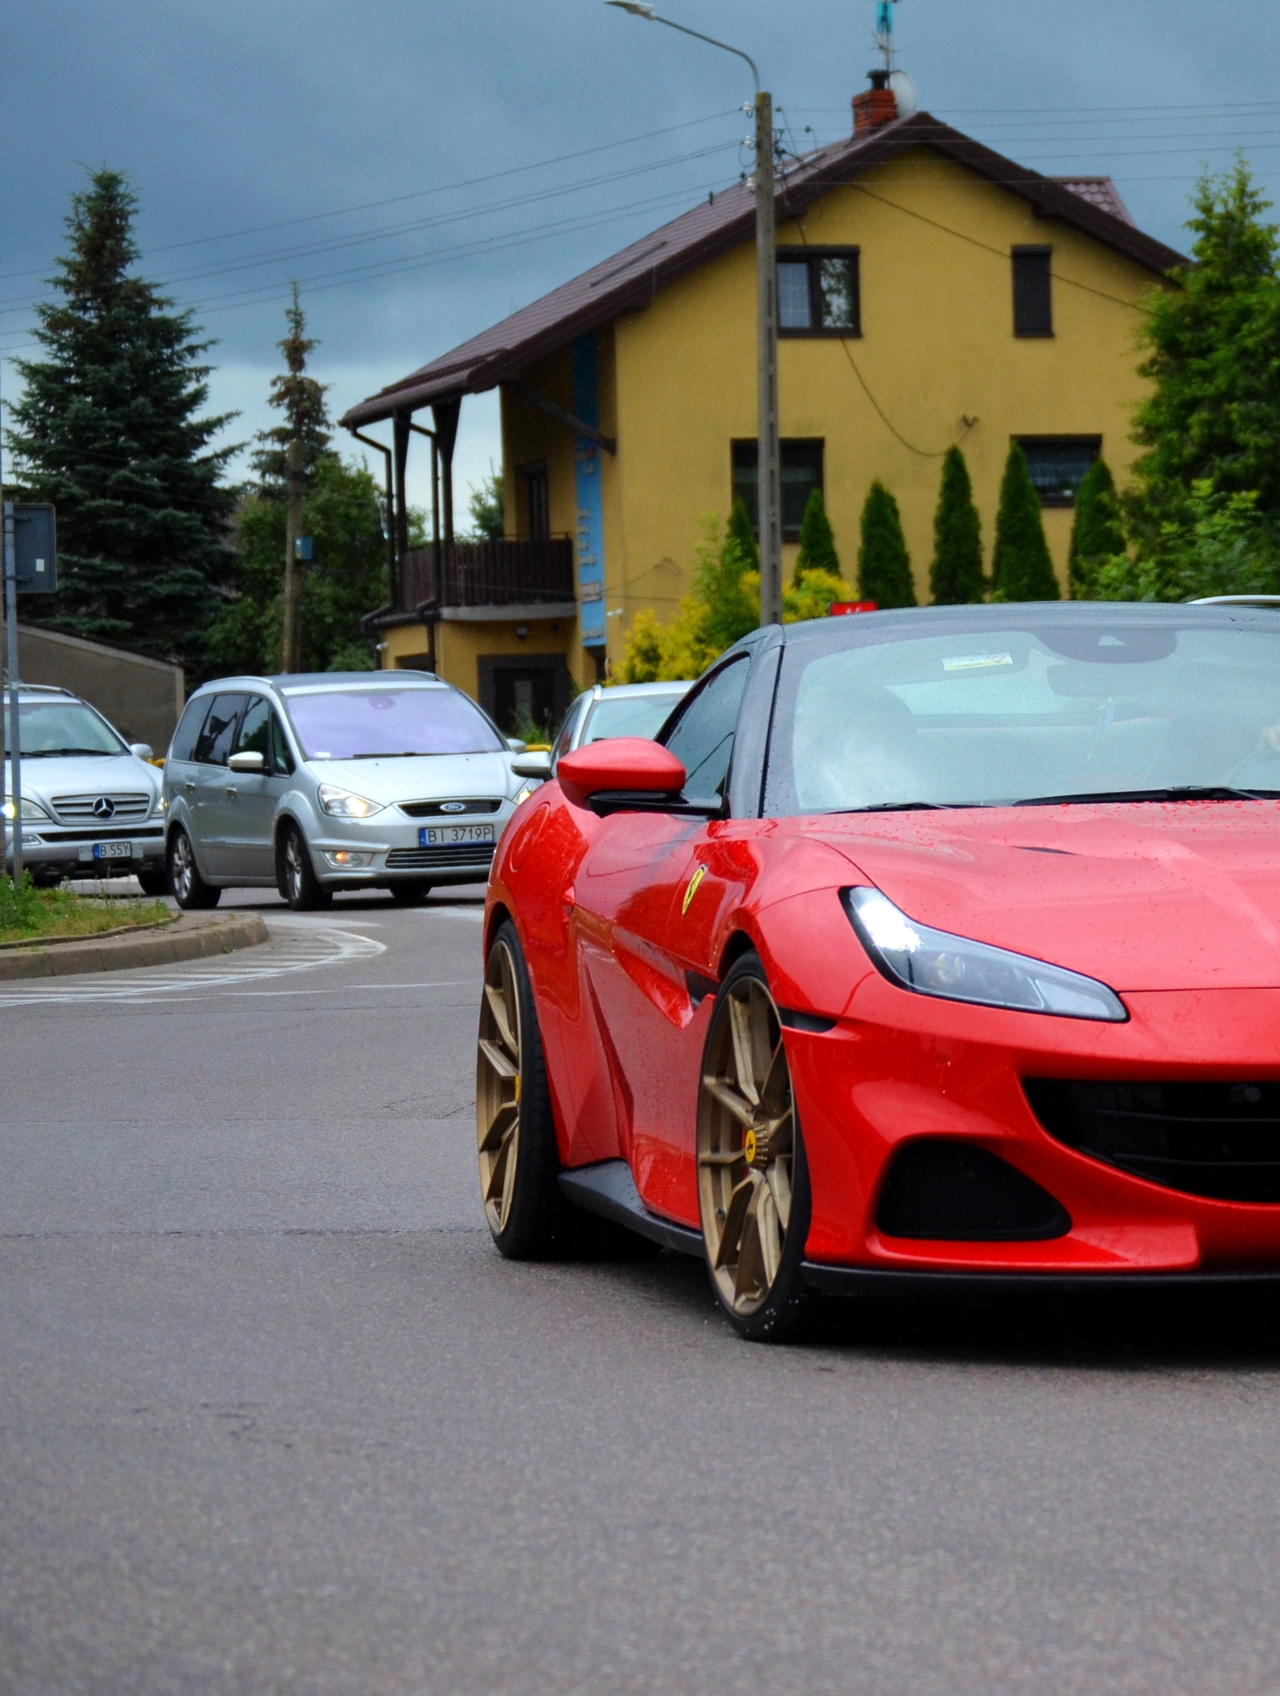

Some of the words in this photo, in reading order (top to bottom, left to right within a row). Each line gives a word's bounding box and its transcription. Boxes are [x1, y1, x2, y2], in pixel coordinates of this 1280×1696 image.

[428, 829, 444, 843] BI
[452, 827, 491, 841] 3719P
[101, 846, 107, 857] B
